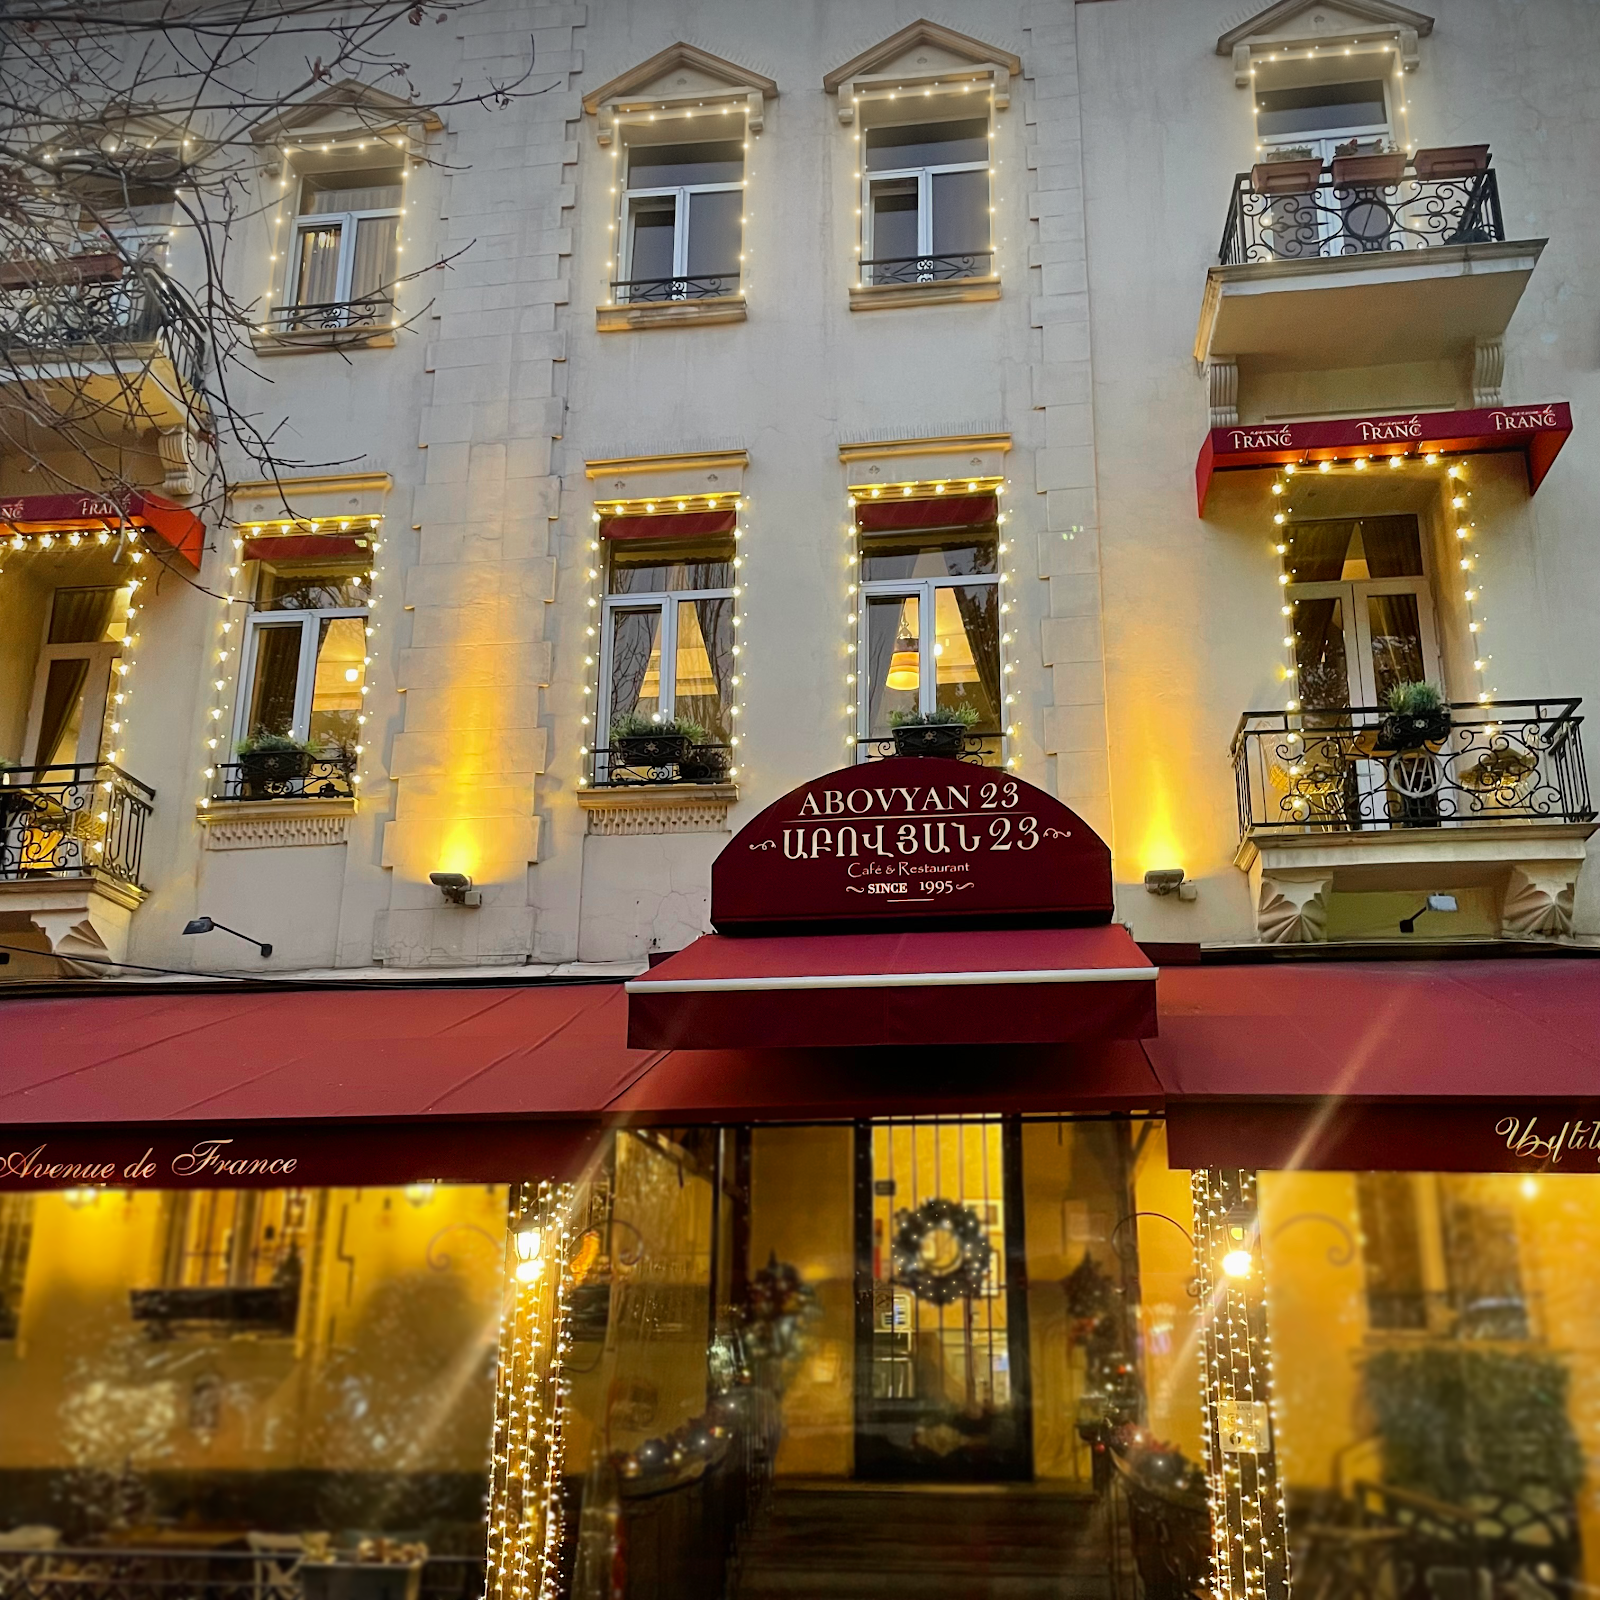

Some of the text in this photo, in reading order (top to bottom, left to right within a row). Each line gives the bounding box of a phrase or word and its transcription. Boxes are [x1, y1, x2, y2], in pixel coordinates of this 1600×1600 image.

[798, 781, 1019, 816] ABOVYAN 23
[782, 816, 1040, 860] ԱԲՈՎՅԱՆ 23
[847, 861, 970, 878] Café & Restaurant
[867, 880, 954, 895] SINCE 1995
[0, 1138, 298, 1179] Avenue de France
